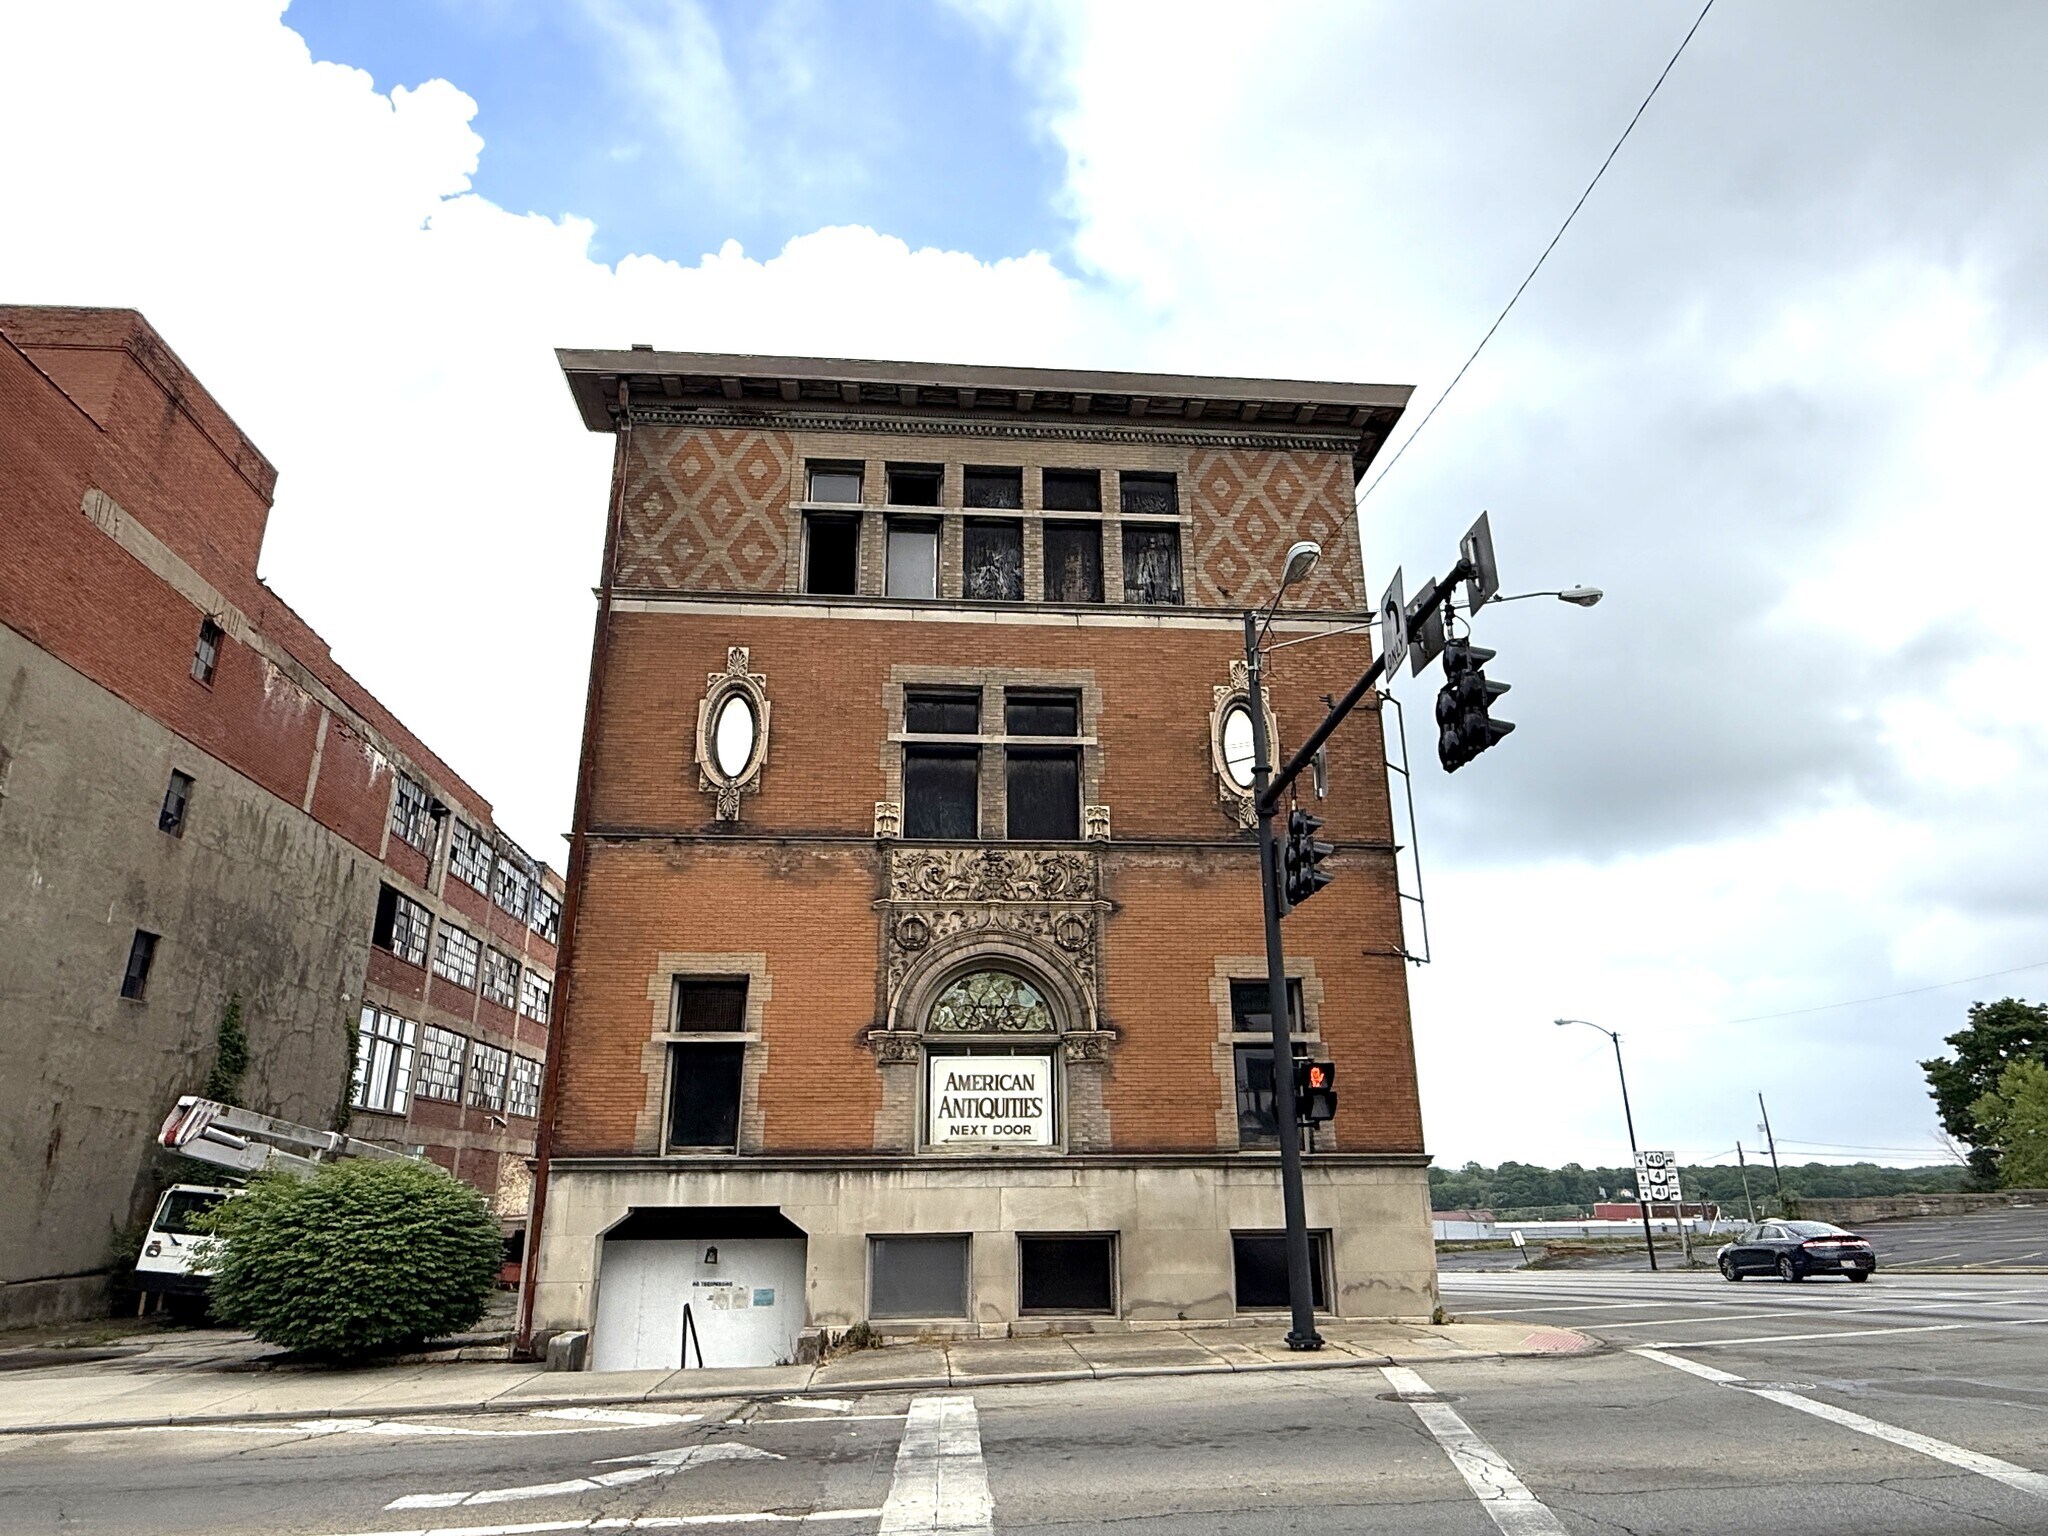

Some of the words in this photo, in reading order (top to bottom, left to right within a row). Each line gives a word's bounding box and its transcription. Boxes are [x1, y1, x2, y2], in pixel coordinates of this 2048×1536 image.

[1387, 634, 1404, 671] ONLY
[944, 1072, 1035, 1091] AMERICAN
[938, 1095, 1043, 1119] ANTIQUITIES
[950, 1125, 987, 1135] NEXT
[993, 1125, 1032, 1135] DOOR
[1648, 1154, 1662, 1164] 40
[1654, 1171, 1661, 1180] 4
[1655, 1187, 1666, 1197] 41
